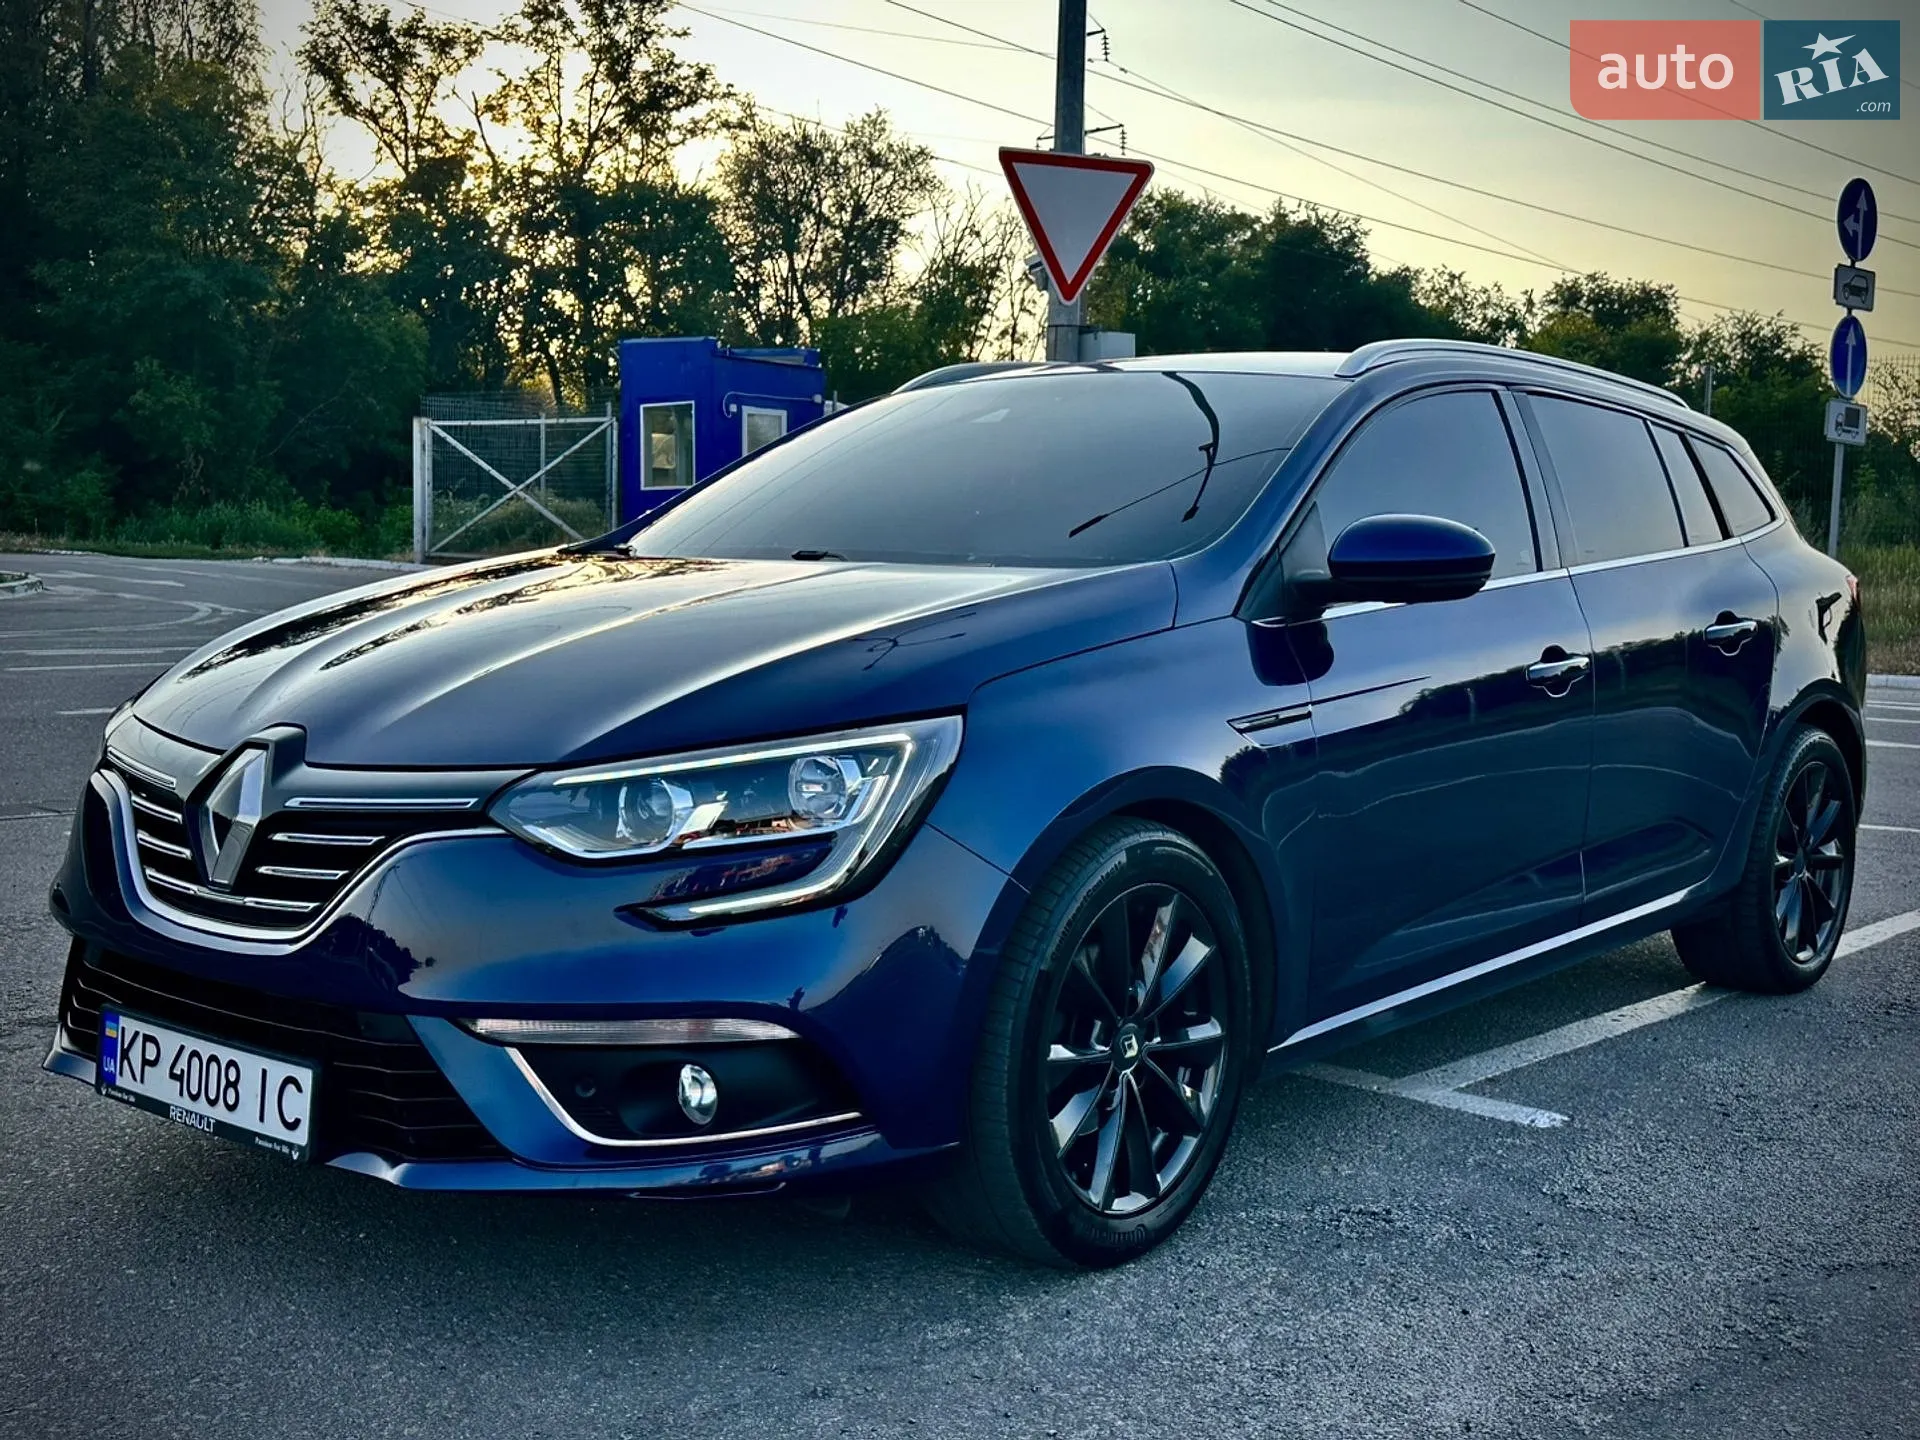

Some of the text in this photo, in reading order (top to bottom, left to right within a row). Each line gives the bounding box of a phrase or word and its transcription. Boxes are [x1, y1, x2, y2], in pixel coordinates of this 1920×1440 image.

[103, 1055, 115, 1074] UA
[118, 1026, 304, 1131] KP 4008 IC
[169, 1105, 216, 1133] RENAULT
